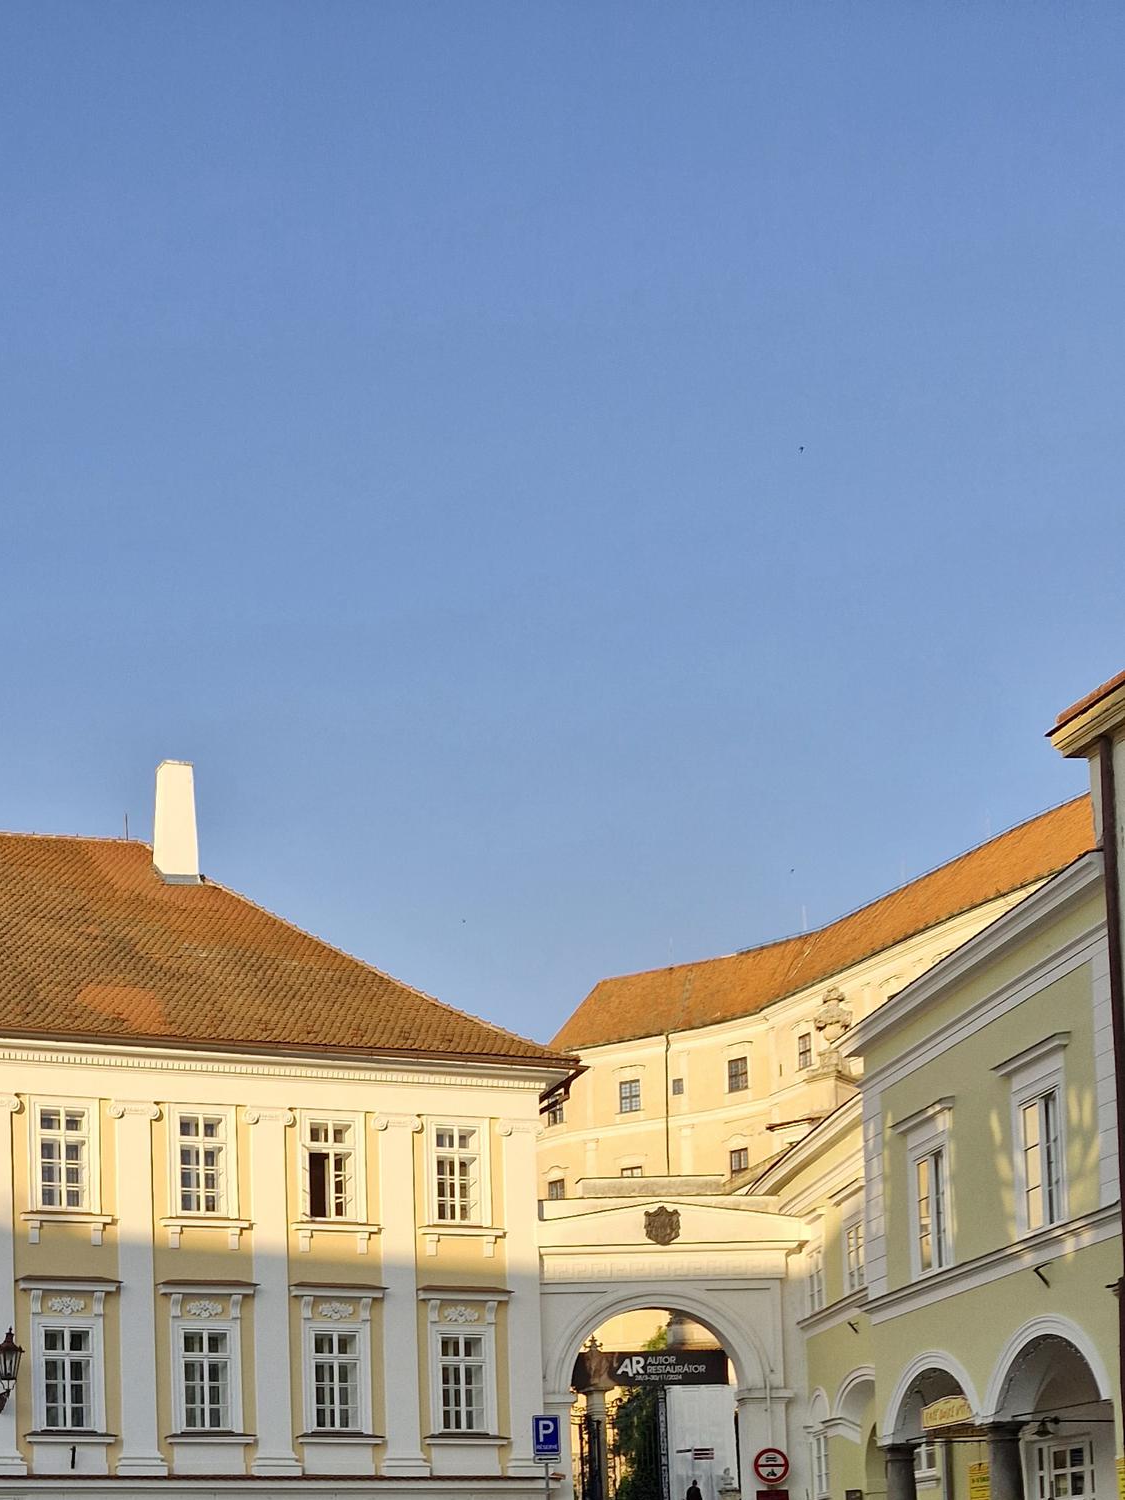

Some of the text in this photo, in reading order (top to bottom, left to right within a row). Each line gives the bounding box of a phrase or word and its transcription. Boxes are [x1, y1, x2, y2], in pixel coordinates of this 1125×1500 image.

[616, 1356, 645, 1377] AR
[646, 1356, 676, 1364] AUTOR
[646, 1363, 706, 1374] RESTAURÁTOR
[539, 1420, 554, 1442] P
